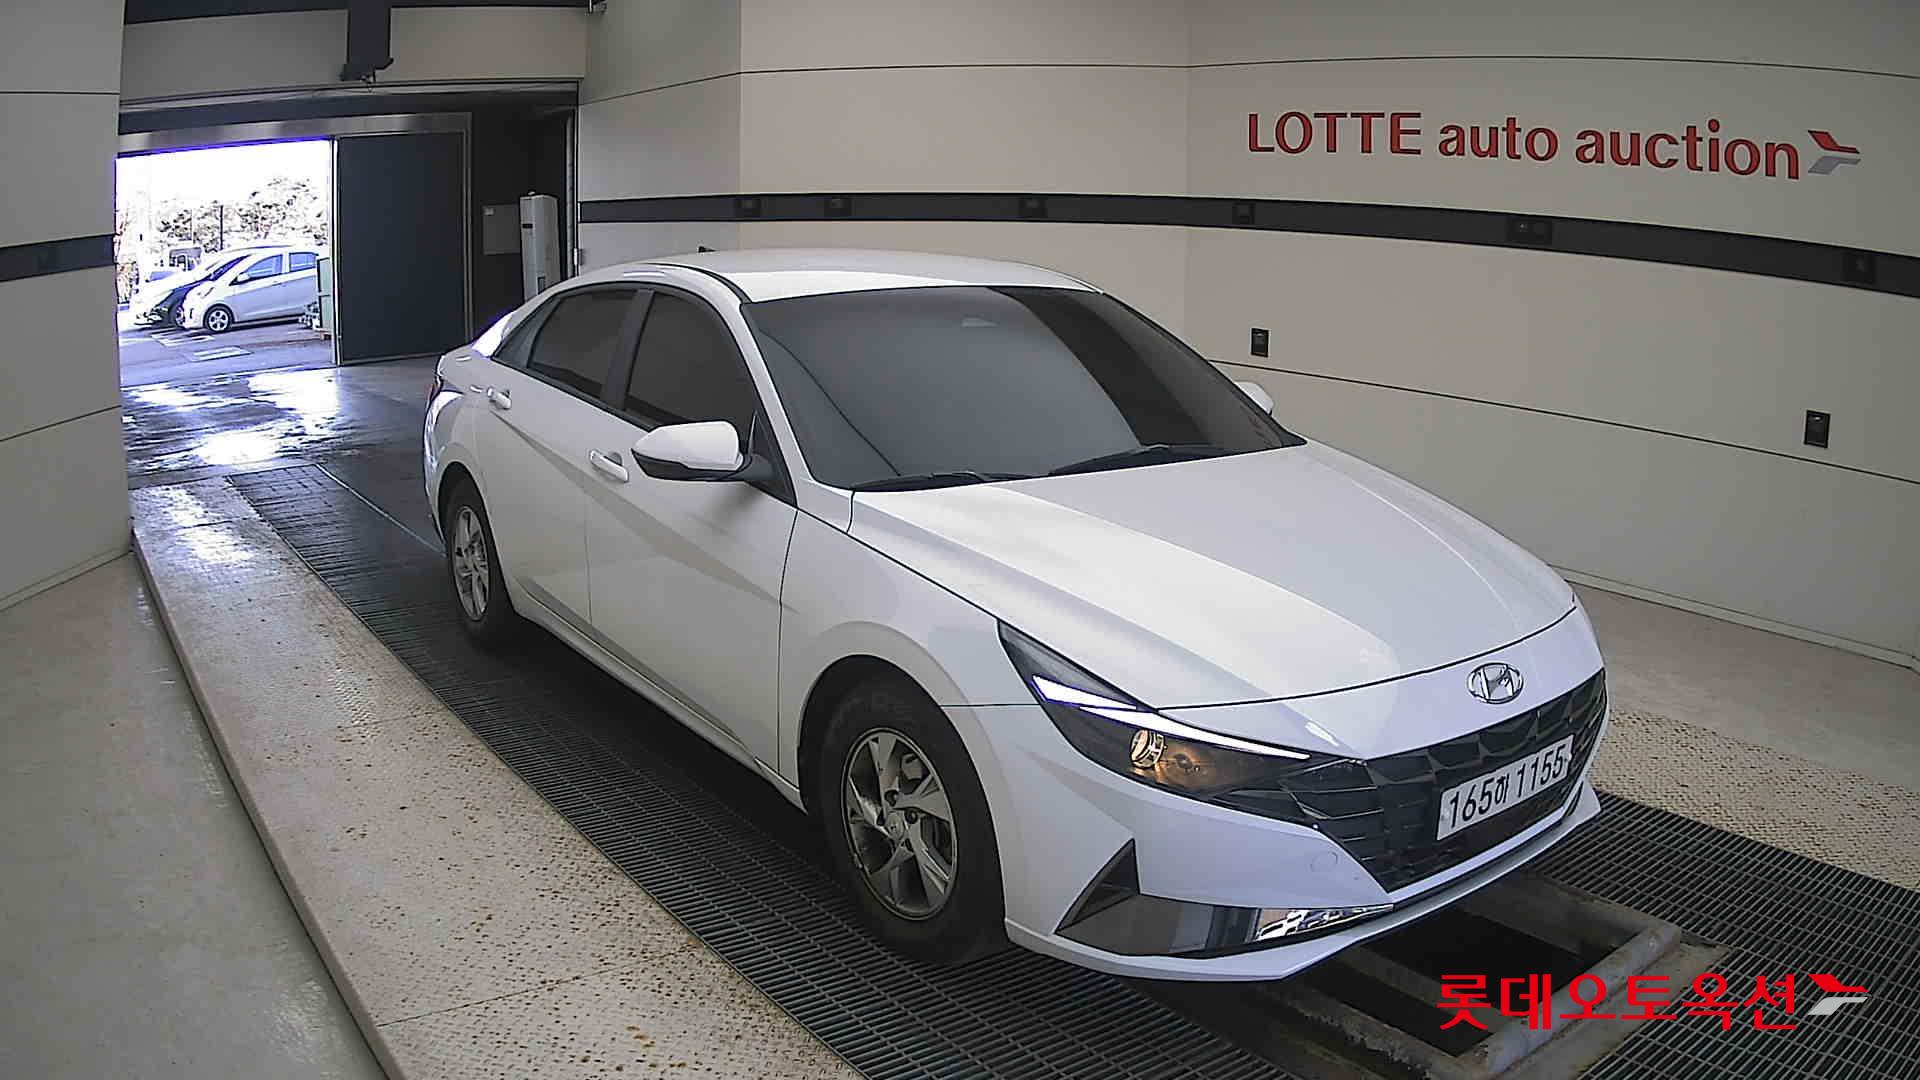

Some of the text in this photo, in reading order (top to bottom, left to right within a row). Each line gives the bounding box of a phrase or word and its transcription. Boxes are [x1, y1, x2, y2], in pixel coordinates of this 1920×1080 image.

[1248, 112, 1799, 179] LOTTE auto auction
[1516, 743, 1567, 798] 1155
